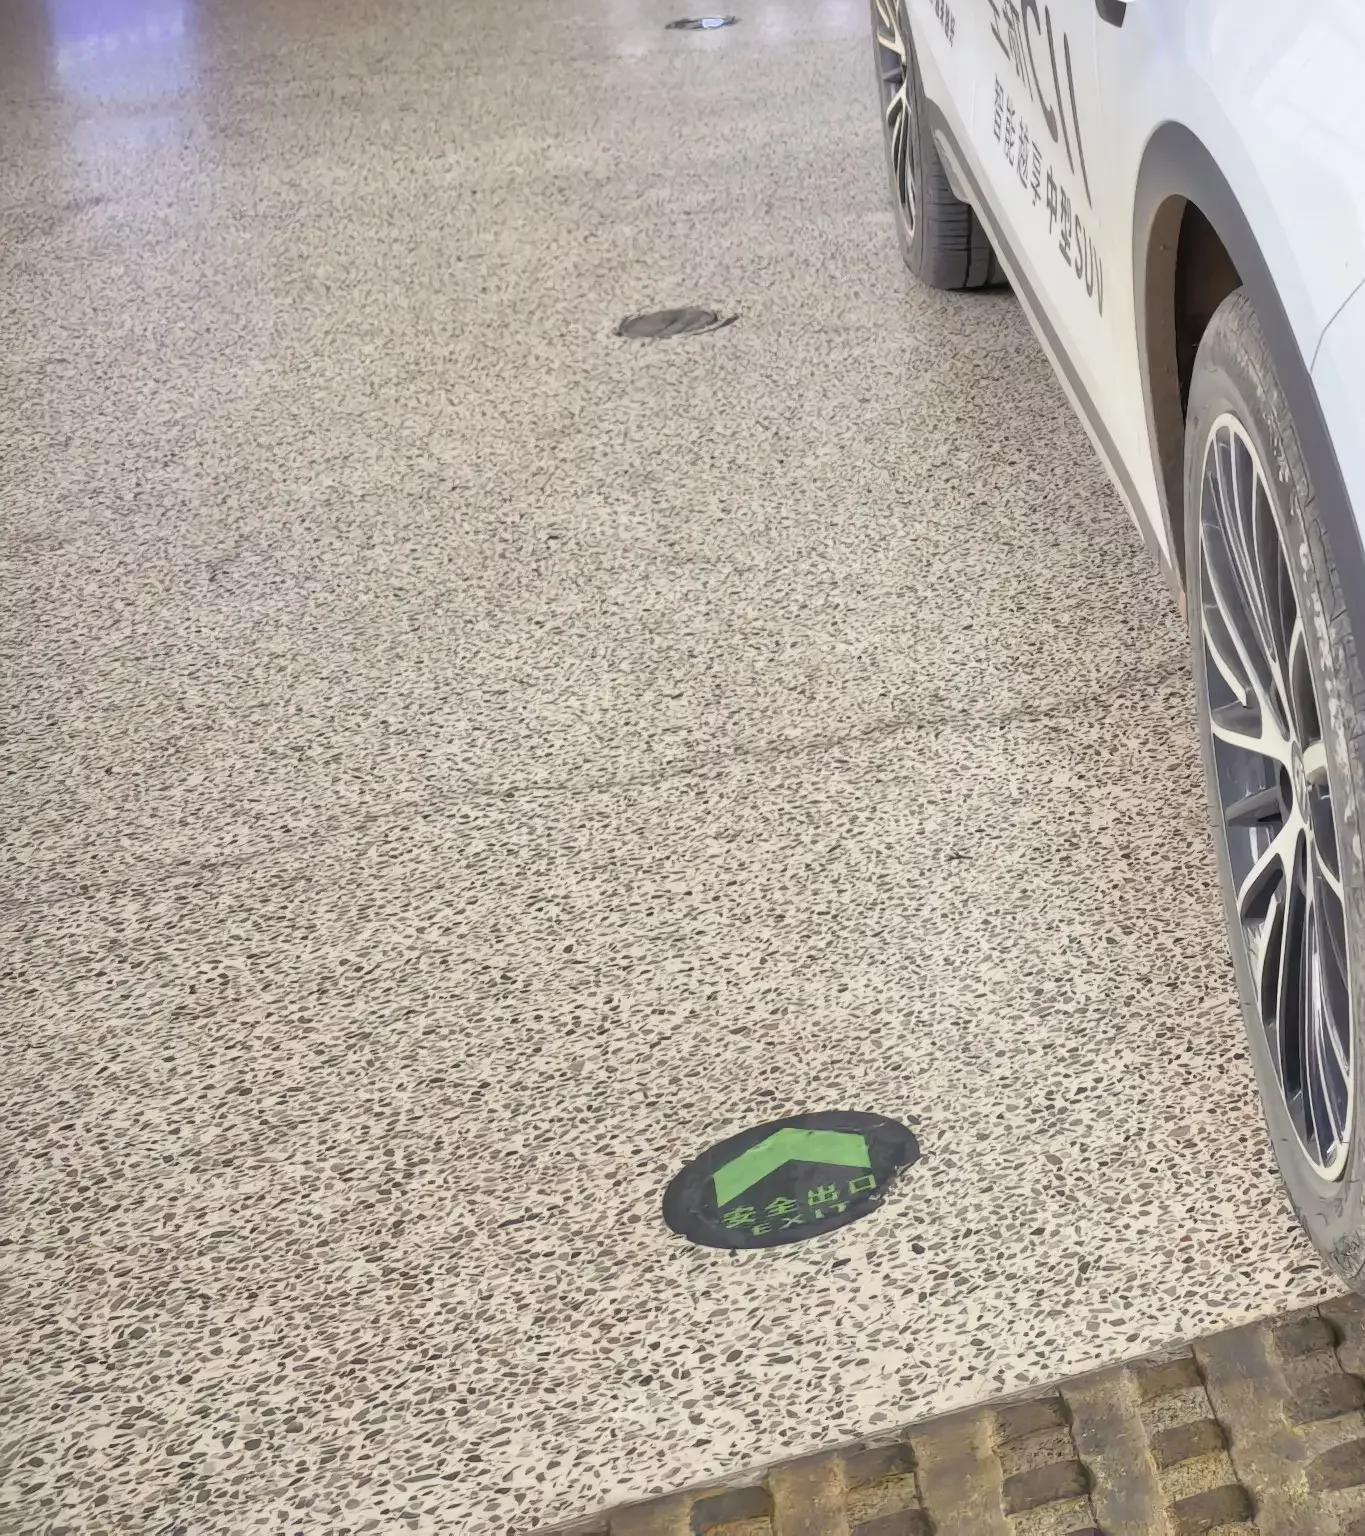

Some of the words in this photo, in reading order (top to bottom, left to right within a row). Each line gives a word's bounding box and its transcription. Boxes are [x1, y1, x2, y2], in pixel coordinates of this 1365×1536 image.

[721, 1175, 877, 1229] 安全出口
[752, 1201, 850, 1236] EXIT
